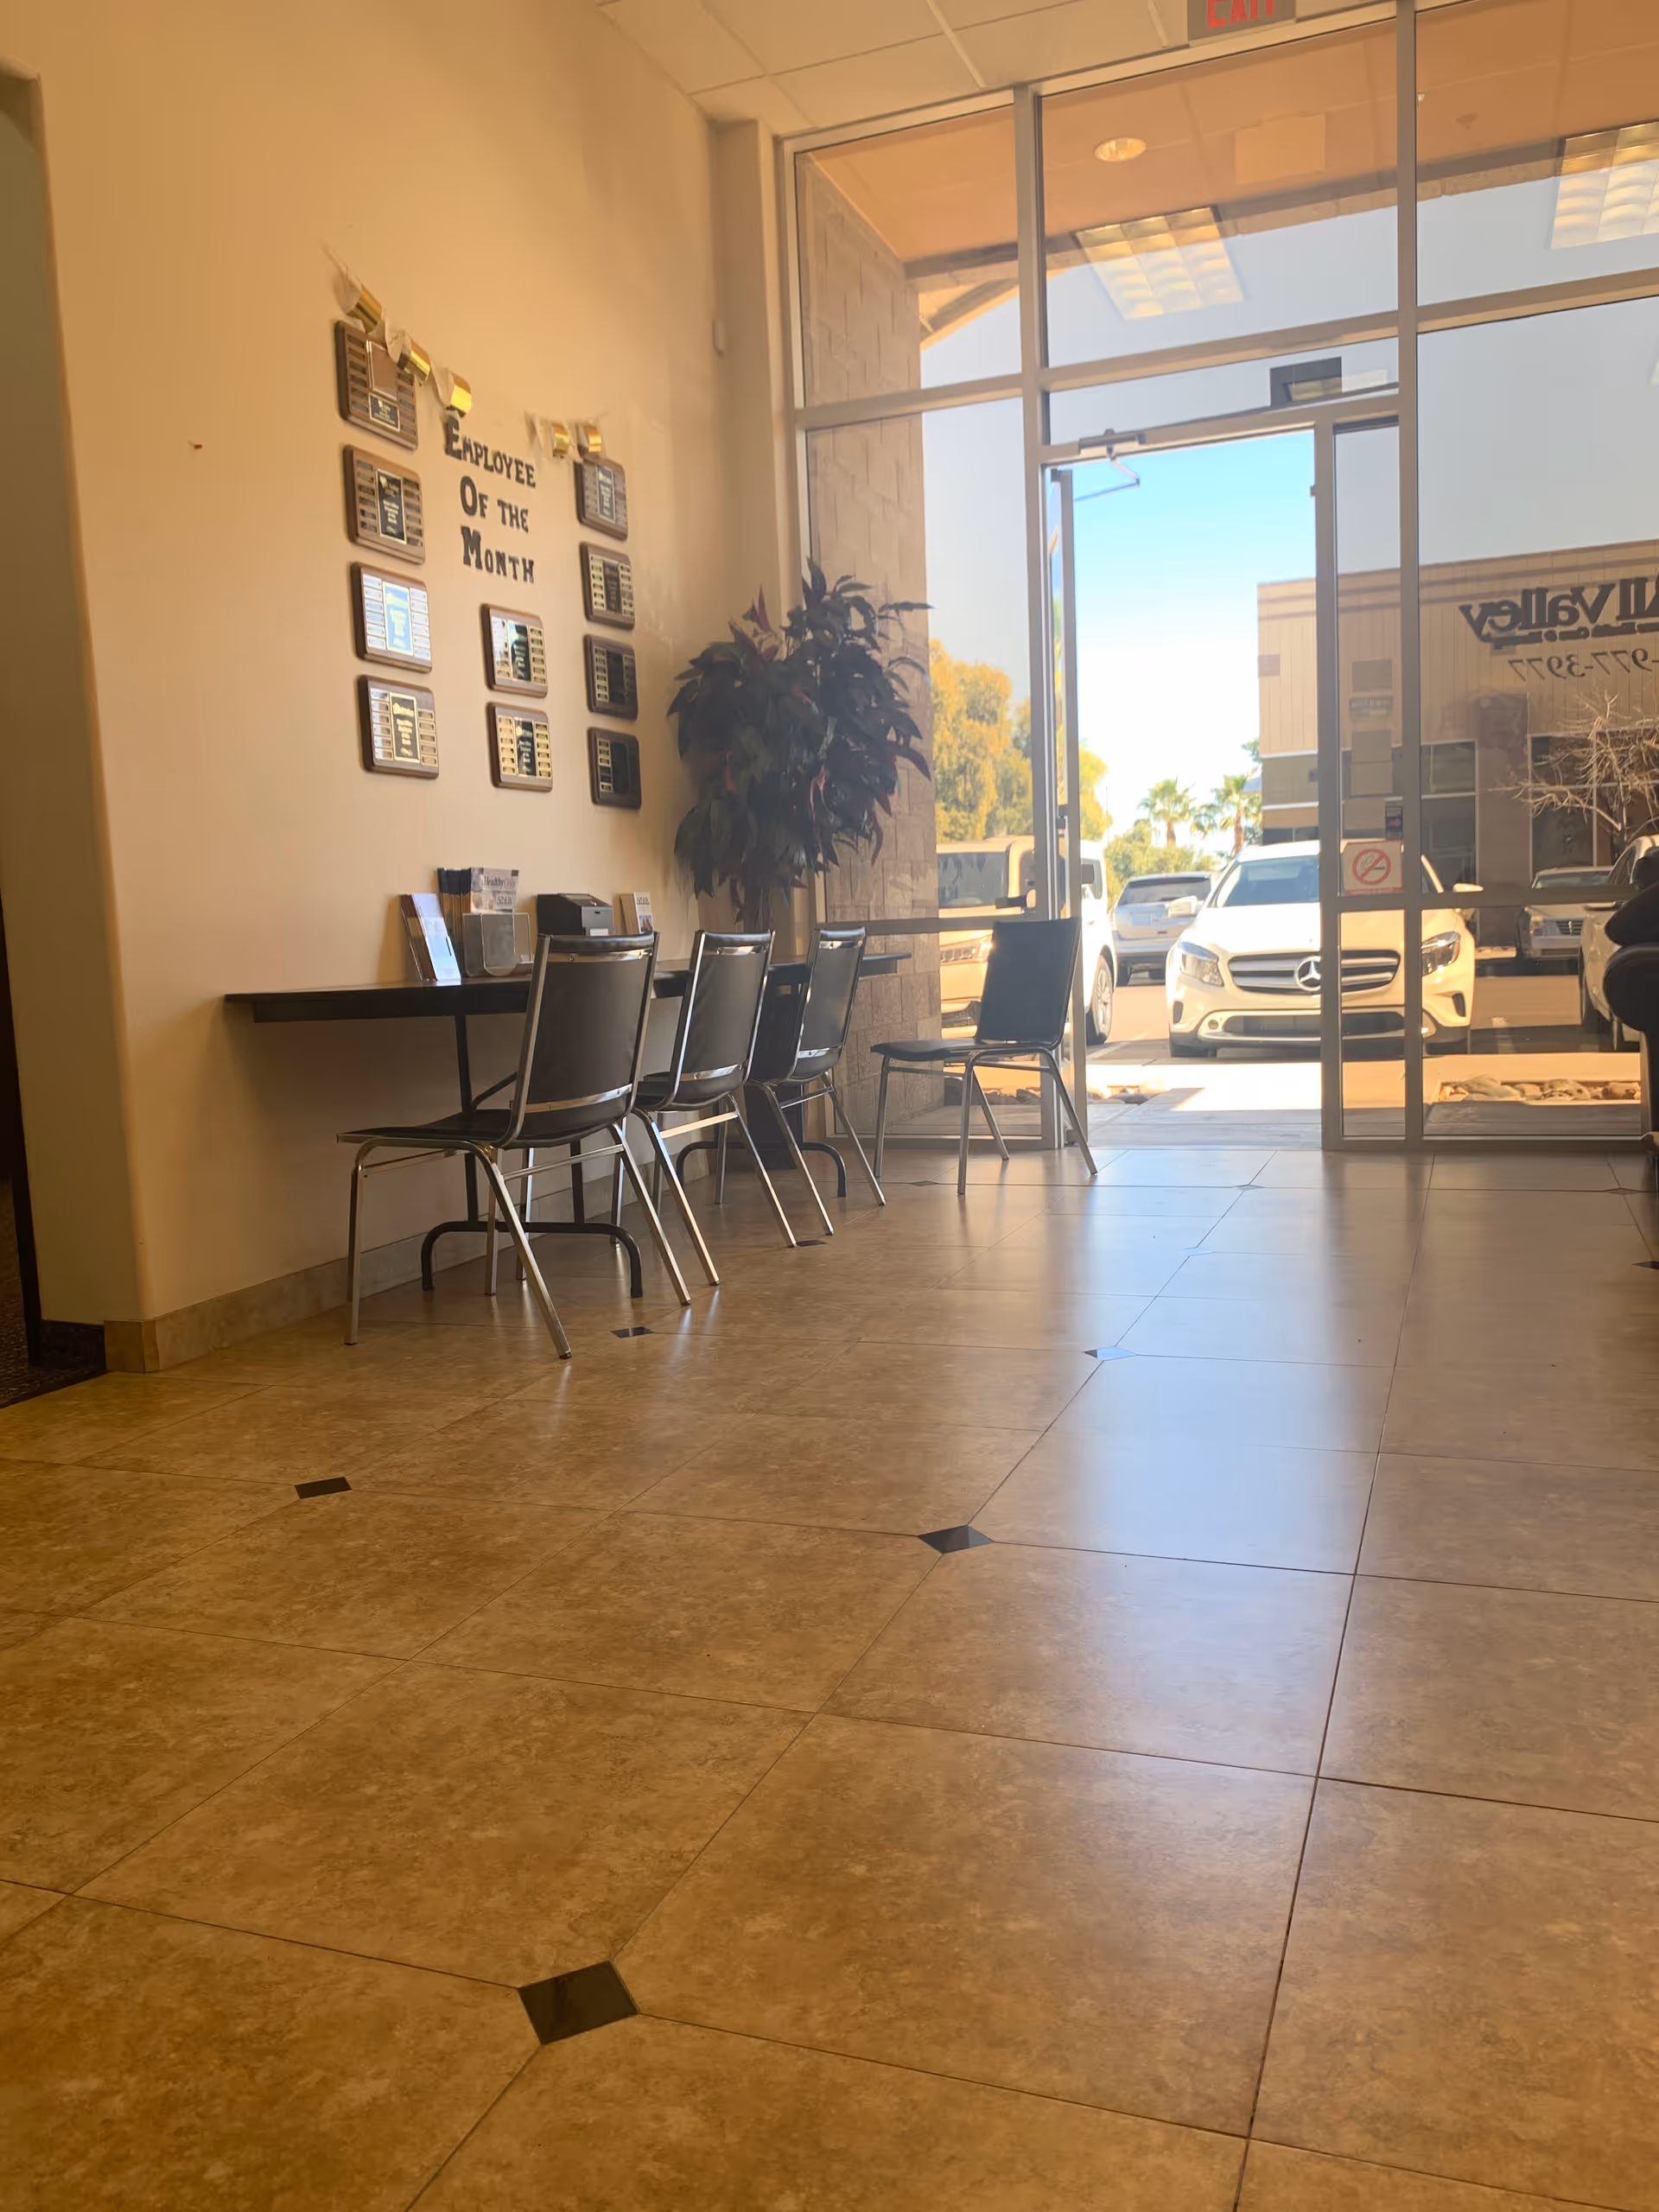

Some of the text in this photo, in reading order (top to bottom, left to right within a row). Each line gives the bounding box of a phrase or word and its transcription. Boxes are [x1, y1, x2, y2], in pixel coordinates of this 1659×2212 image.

[445, 416, 536, 488] EMPLOYEE
[460, 475, 529, 533] OF THE
[461, 525, 535, 584] MONTH
